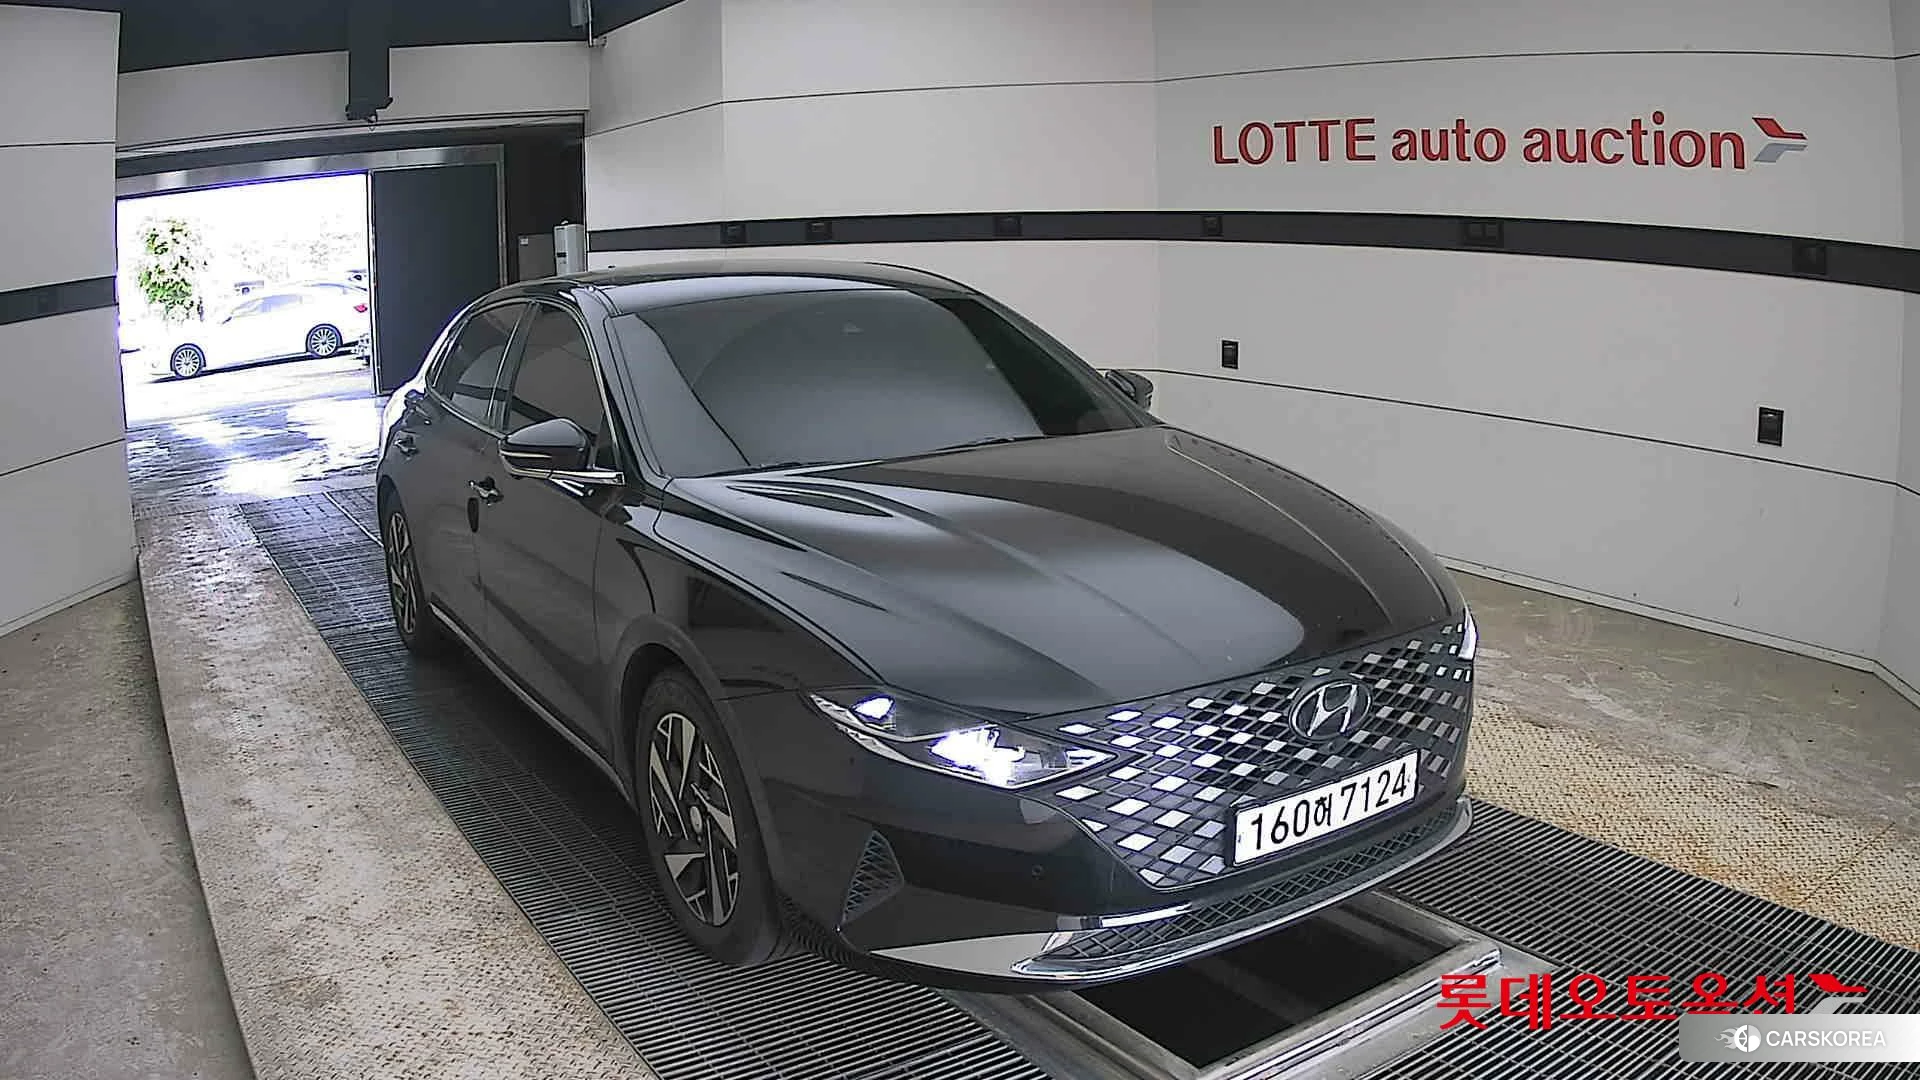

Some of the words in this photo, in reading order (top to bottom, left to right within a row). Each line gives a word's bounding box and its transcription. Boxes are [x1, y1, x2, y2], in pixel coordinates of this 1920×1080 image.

[1212, 118, 1376, 165] LOTTE
[1391, 118, 1507, 163] auto
[1523, 111, 1747, 170] auction
